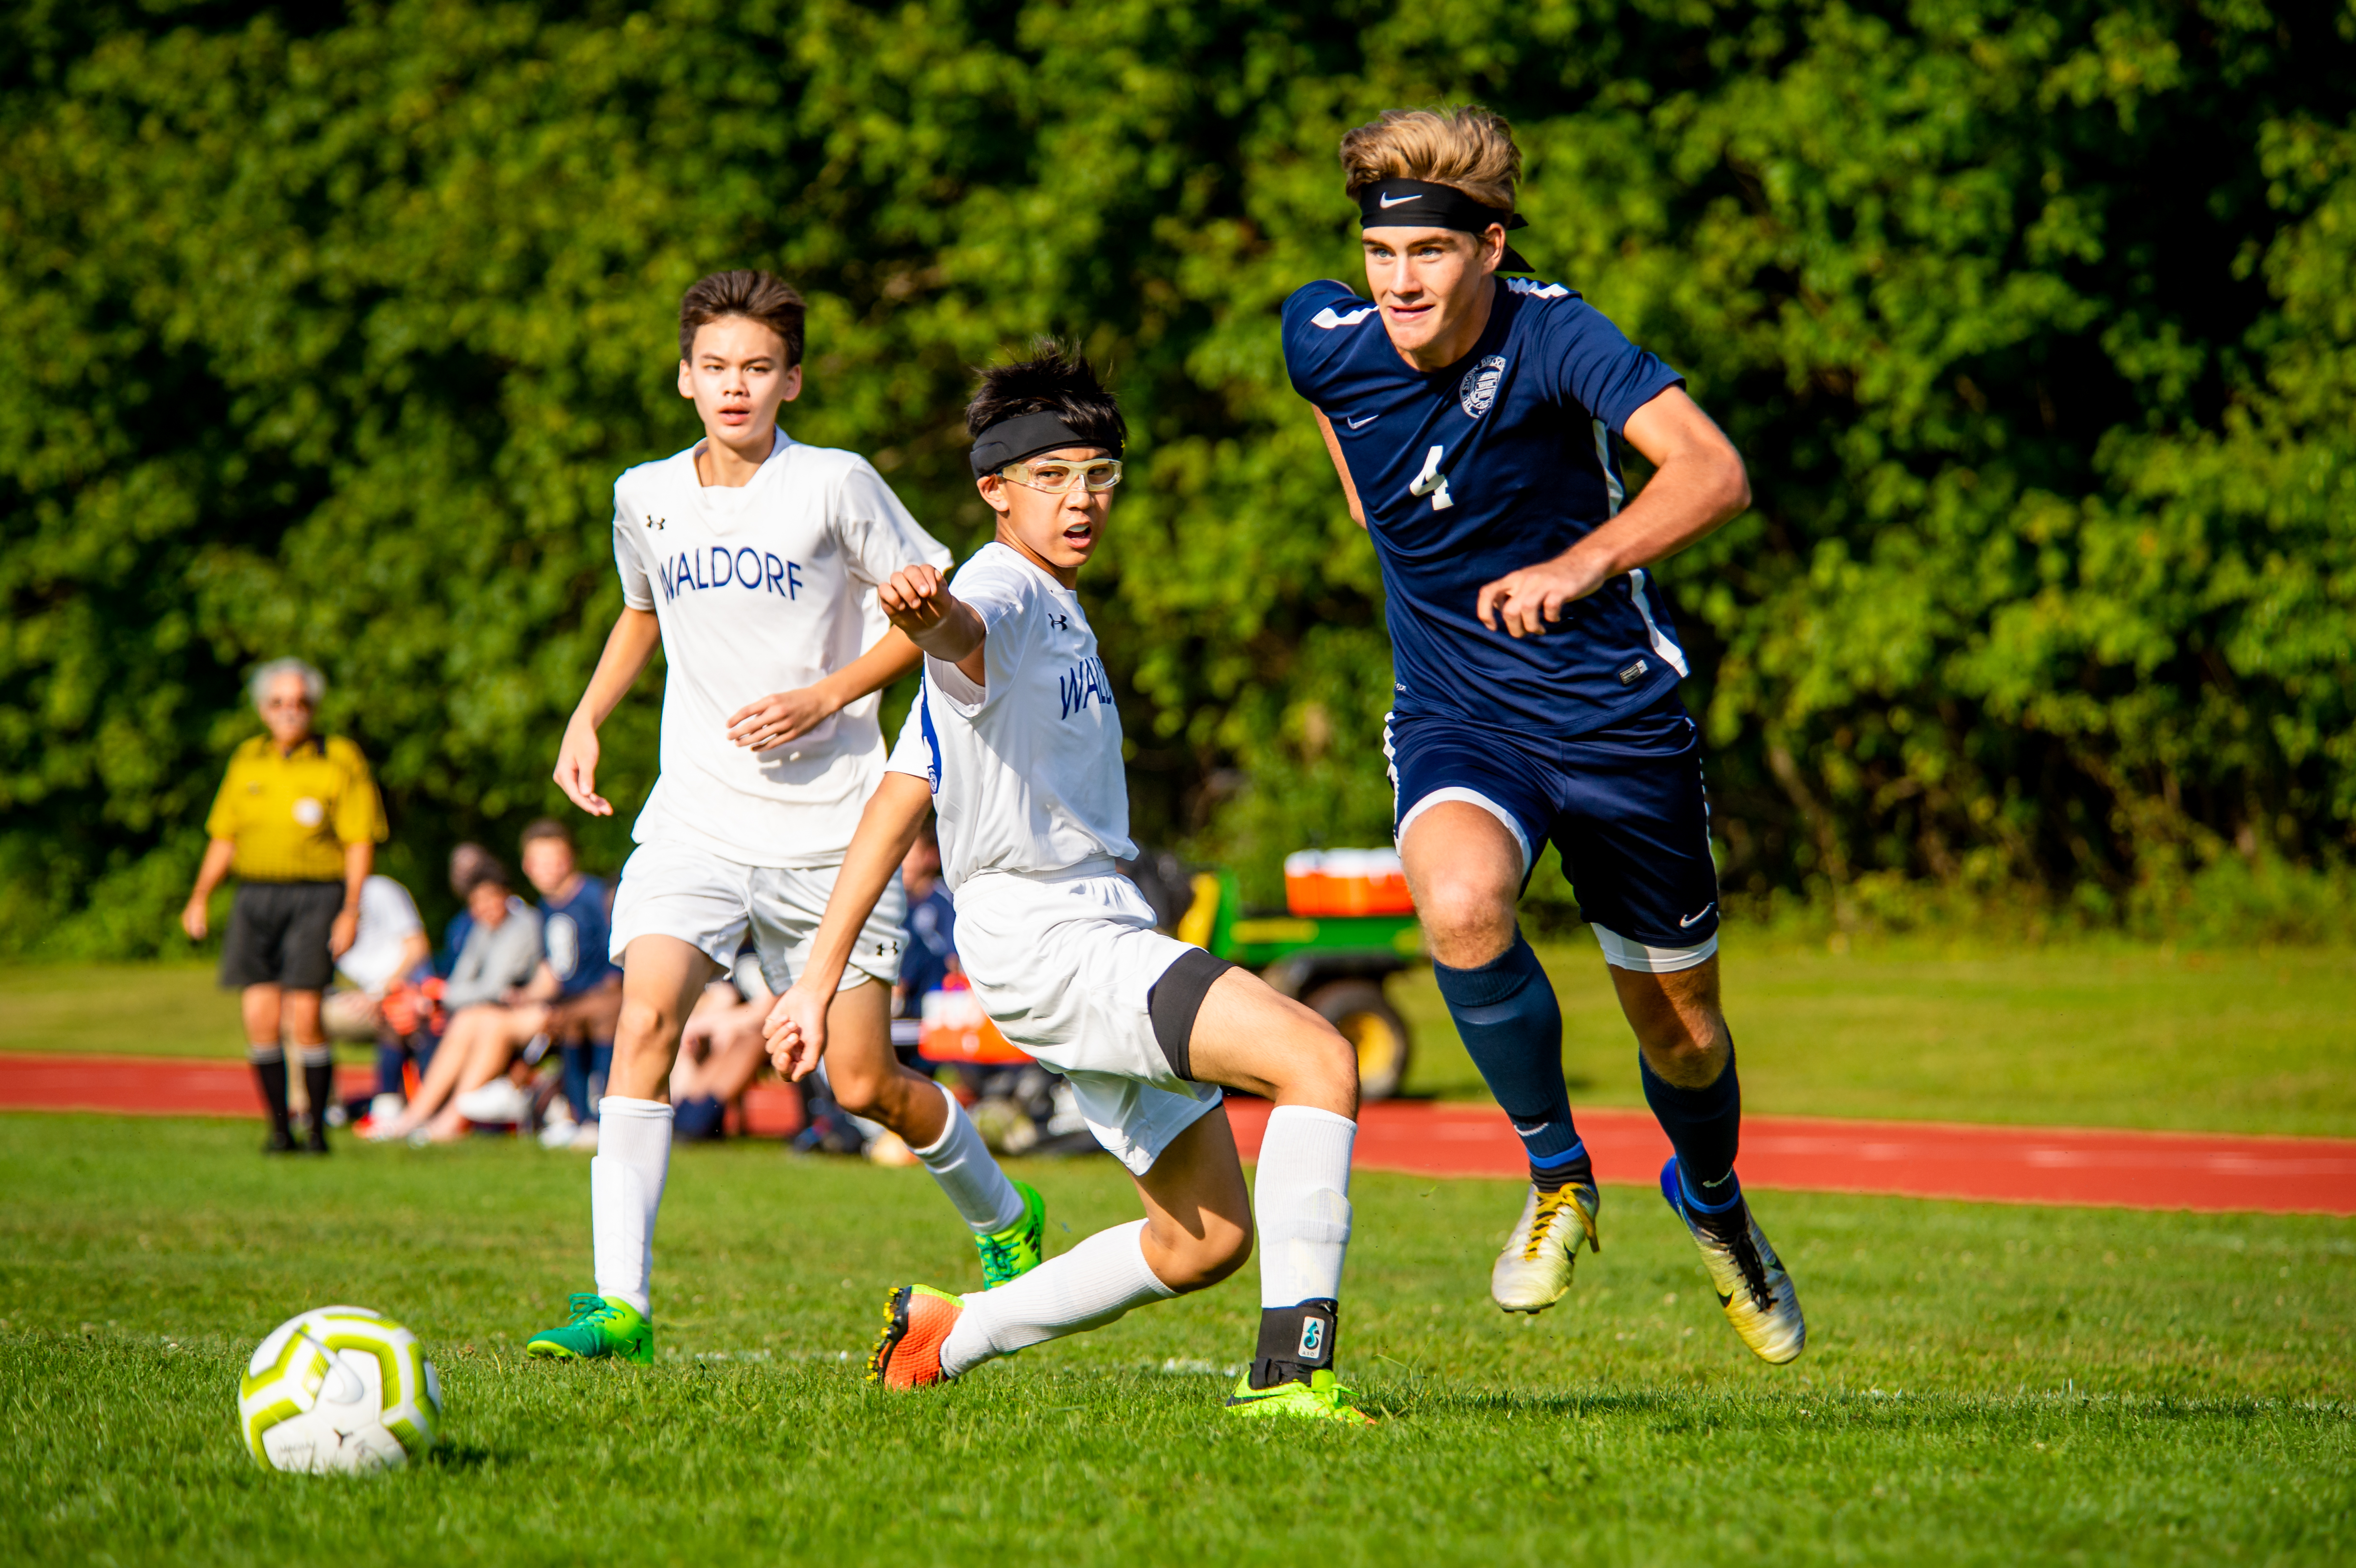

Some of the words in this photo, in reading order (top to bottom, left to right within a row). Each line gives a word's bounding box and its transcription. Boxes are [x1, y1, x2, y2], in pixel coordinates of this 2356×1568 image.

[1410, 445, 1454, 510] 4
[657, 546, 802, 606] WALDORF
[1059, 656, 1113, 720] WALD
